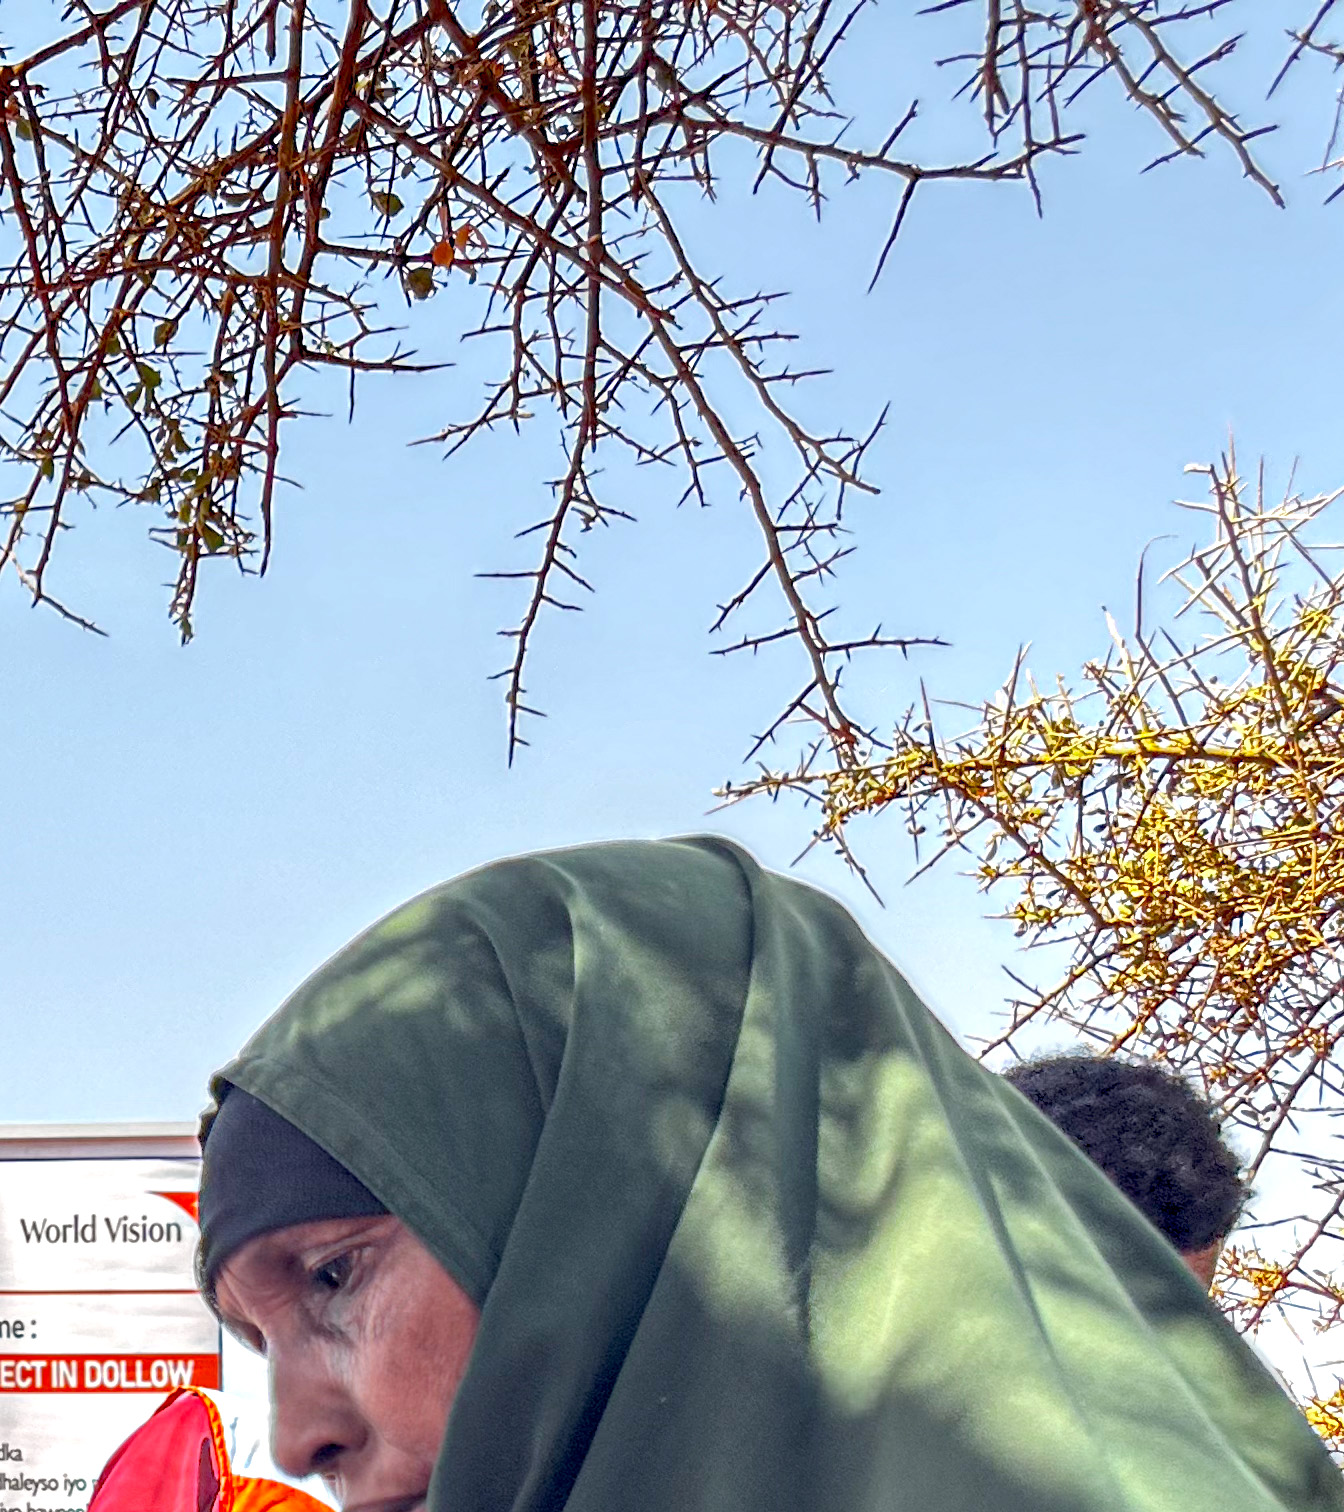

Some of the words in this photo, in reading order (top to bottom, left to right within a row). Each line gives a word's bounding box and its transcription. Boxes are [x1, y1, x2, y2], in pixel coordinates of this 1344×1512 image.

[21, 1214, 96, 1243] World
[105, 1216, 181, 1243] Vision
[52, 1361, 76, 1387] IN
[85, 1360, 195, 1388] DOLLOW
[64, 1474, 86, 1496] iyo
